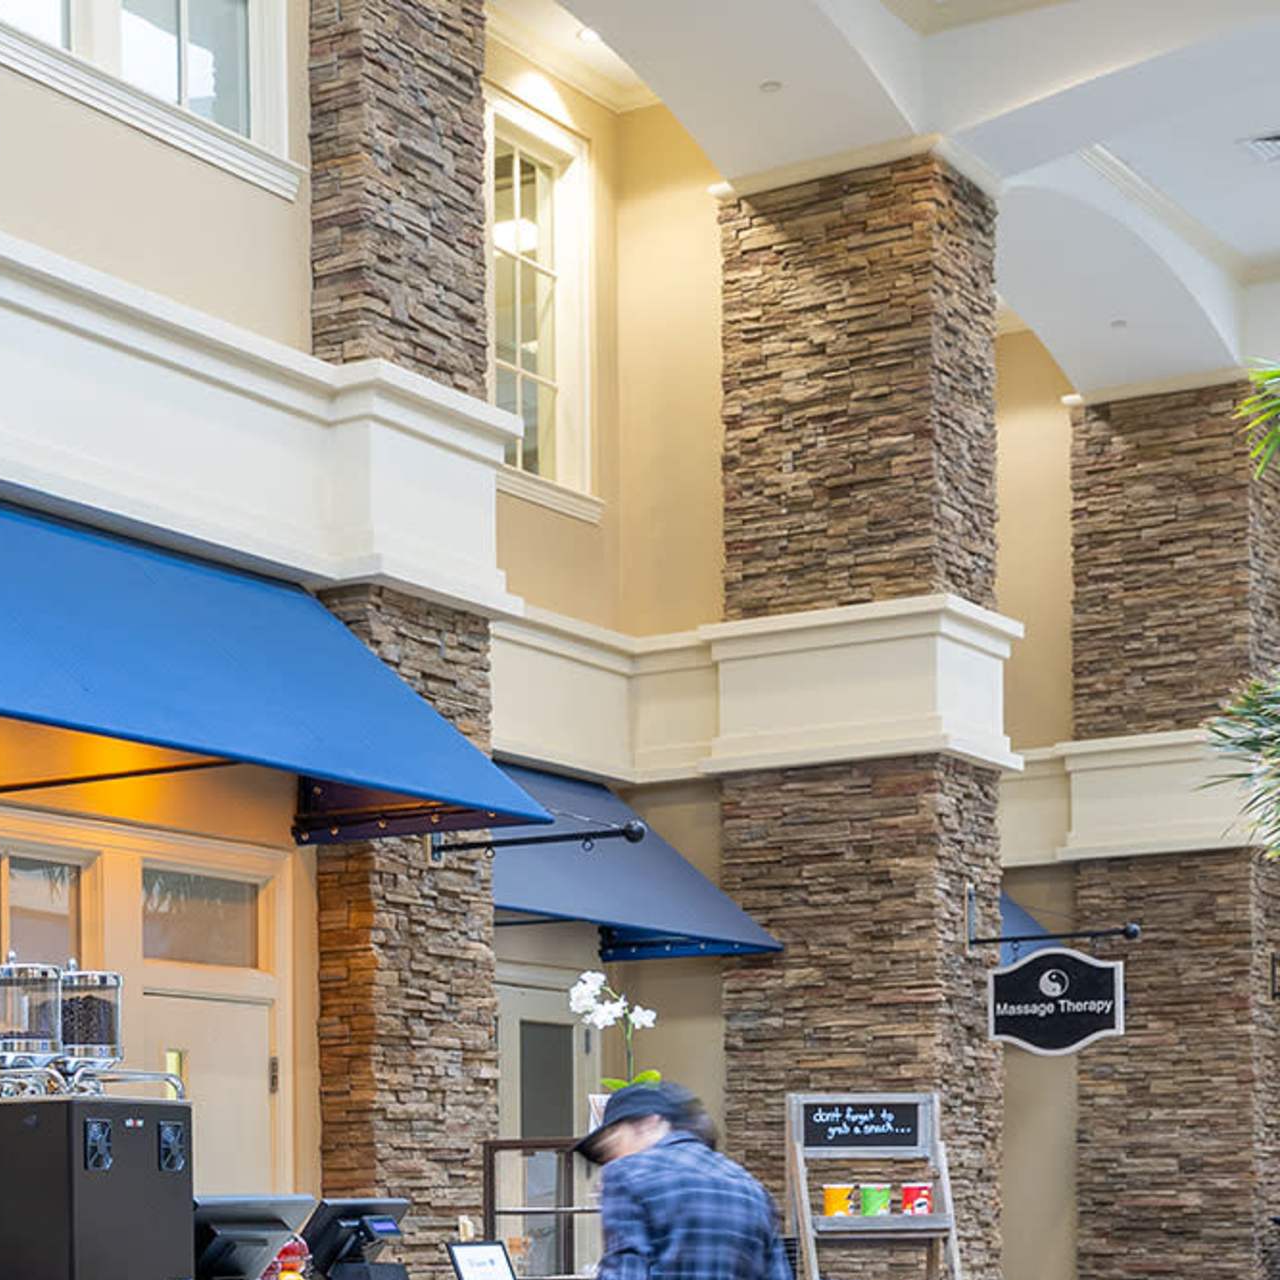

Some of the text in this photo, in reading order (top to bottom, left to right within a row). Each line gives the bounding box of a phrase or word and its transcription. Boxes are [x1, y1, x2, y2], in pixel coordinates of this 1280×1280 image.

[996, 999, 1112, 1017] Massage Therapy
[881, 1108, 895, 1122] to
[827, 1122, 850, 1140] grab
[853, 1125, 861, 1134] a
